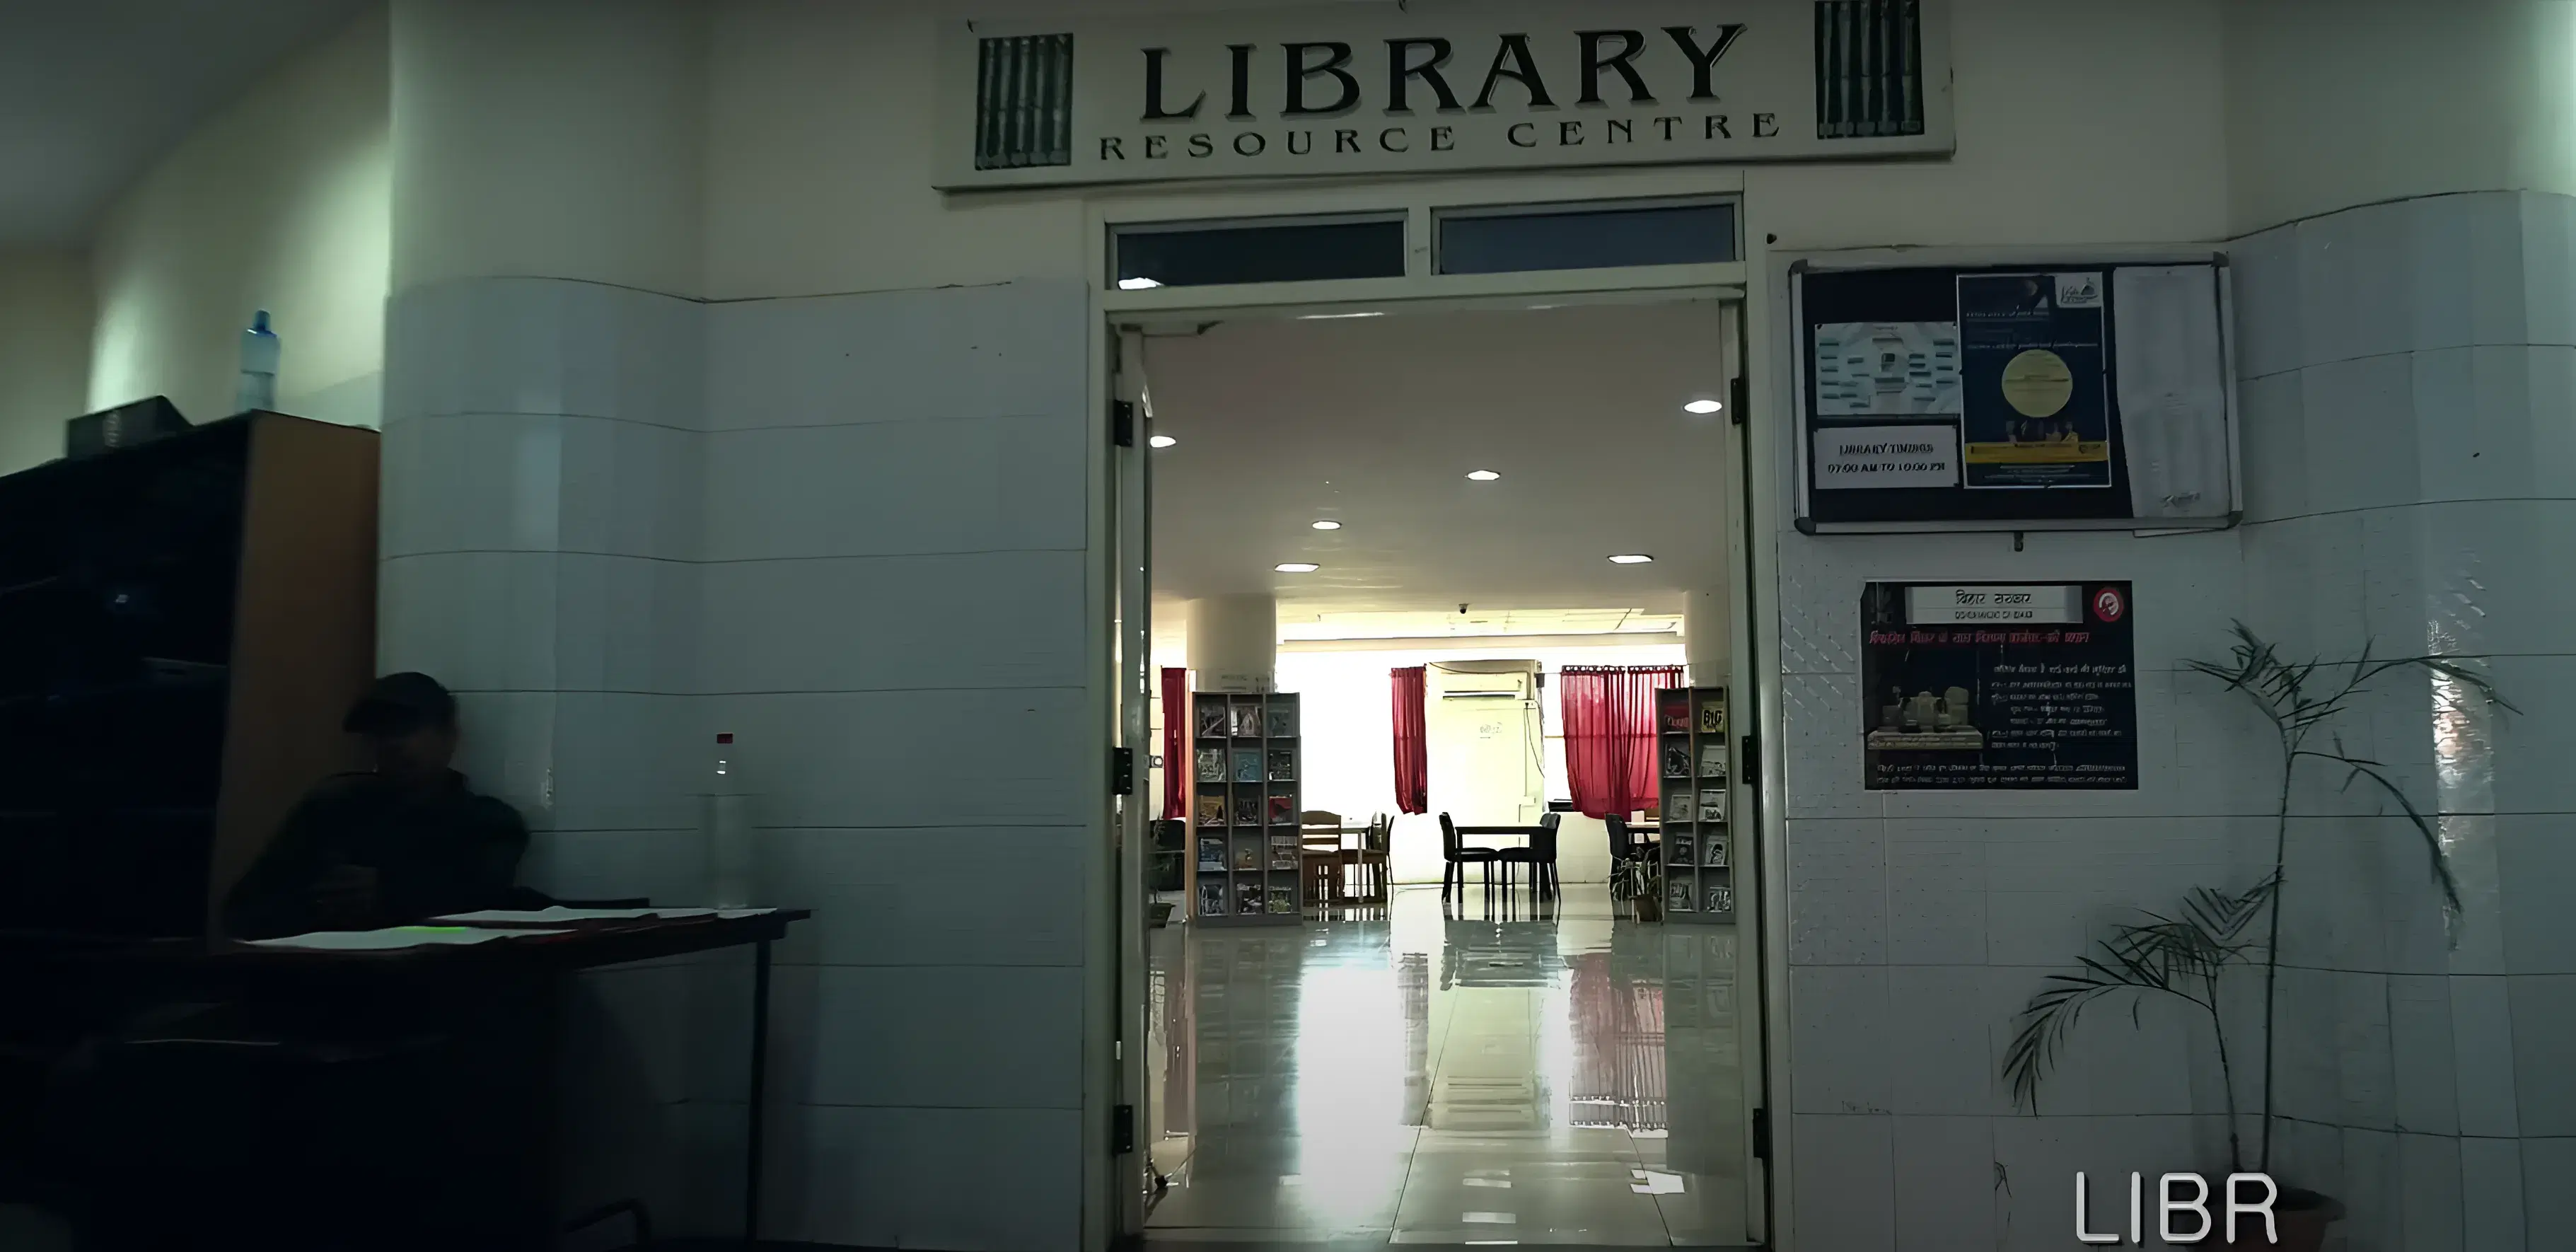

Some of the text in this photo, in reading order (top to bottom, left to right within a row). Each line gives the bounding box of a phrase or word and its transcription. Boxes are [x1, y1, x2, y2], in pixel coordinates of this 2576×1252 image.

[1140, 23, 1748, 122] LIBRARY
[1100, 112, 1780, 161] RESOURCE CENTRE
[1860, 463, 1878, 473] AM
[1881, 463, 1896, 472] TO
[1929, 463, 1945, 471] PM
